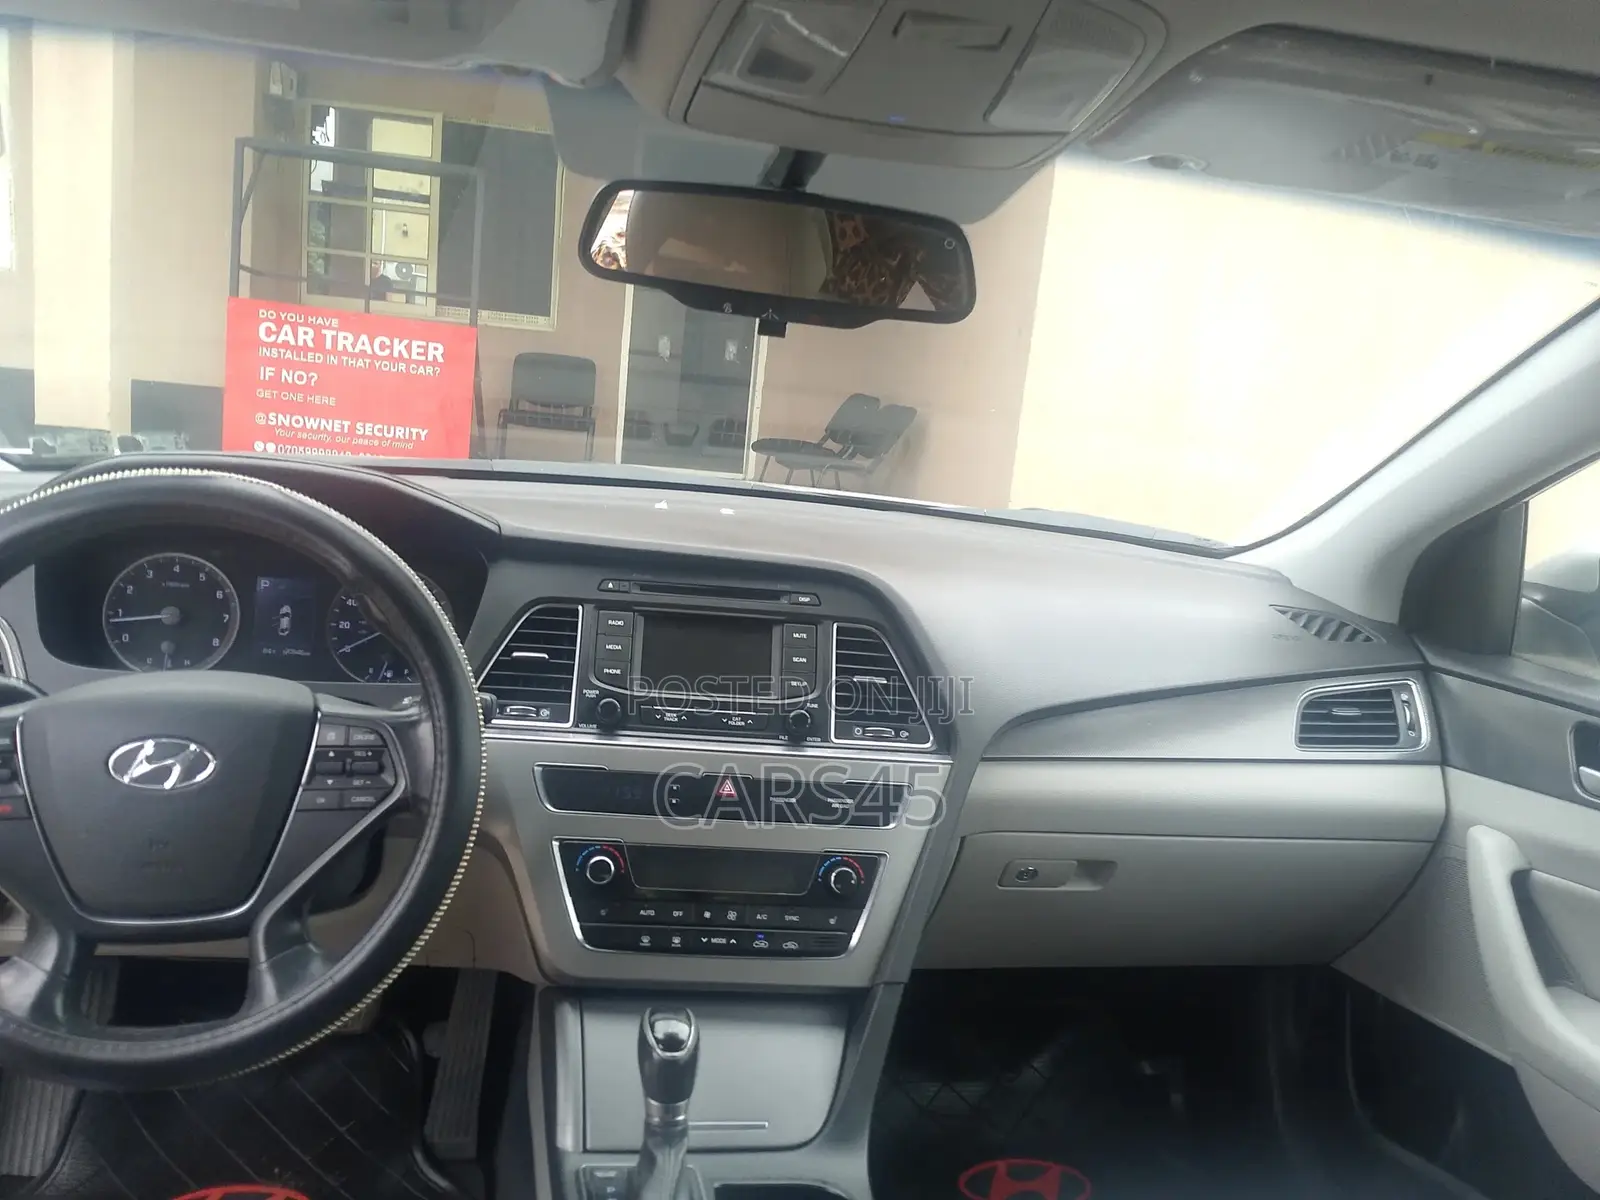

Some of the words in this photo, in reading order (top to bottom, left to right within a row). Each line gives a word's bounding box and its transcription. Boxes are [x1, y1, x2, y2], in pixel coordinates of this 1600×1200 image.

[257, 309, 277, 320] DO
[279, 311, 305, 323] YOU
[307, 315, 339, 328] HAVE
[258, 321, 315, 348] CAR
[321, 328, 445, 363] TRACKER
[258, 345, 324, 363] INSTALLED
[326, 354, 338, 365] IN
[341, 355, 372, 369] THAT
[373, 359, 407, 373] YOUR
[409, 363, 441, 377] CAR?
[259, 366, 276, 381] IF
[281, 367, 319, 386] NO?
[256, 388, 279, 399] GET
[280, 391, 305, 402] ONE
[307, 394, 337, 406] HERE
[255, 411, 351, 434] @SNOWNET
[355, 421, 429, 441] SECURITY
[274, 427, 296, 437] Your
[335, 435, 351, 444] our
[351, 437, 380, 447] peace
[381, 439, 391, 448] of
[391, 441, 415, 450] mind
[173, 564, 180, 573] 4
[146, 569, 153, 579] 3
[199, 572, 206, 581] 5
[260, 579, 270, 589] P
[126, 585, 134, 595] 2
[216, 590, 223, 599] 6
[118, 608, 123, 617] 1
[223, 613, 229, 623] 7
[608, 619, 624, 627] RADIO
[339, 621, 351, 629] 20
[122, 633, 129, 642] 0
[212, 638, 220, 647] 8
[605, 643, 622, 651] MEDIA
